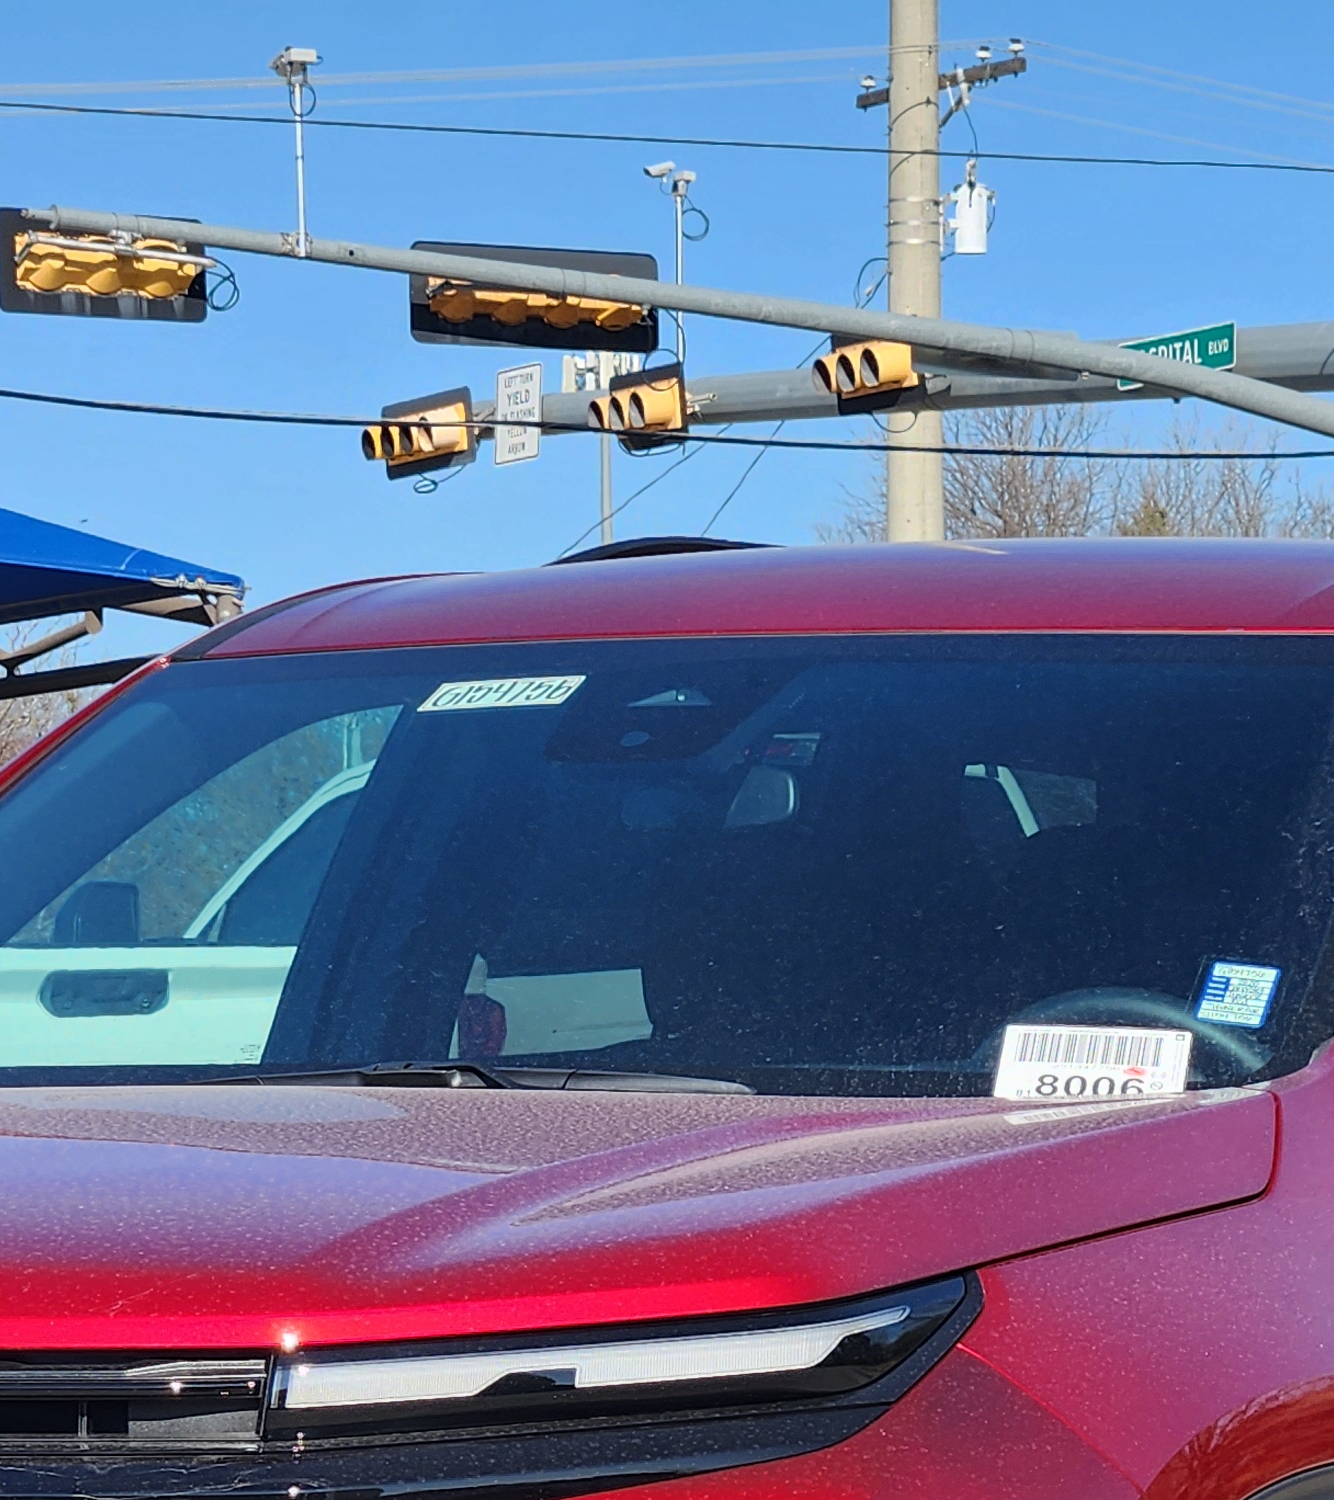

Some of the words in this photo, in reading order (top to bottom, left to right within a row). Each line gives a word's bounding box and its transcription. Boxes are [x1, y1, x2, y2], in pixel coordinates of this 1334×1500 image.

[1141, 338, 1202, 363] PITAL
[1208, 337, 1228, 355] BLVD
[507, 388, 529, 406] YIELD
[1035, 1074, 1145, 1098] 8006
